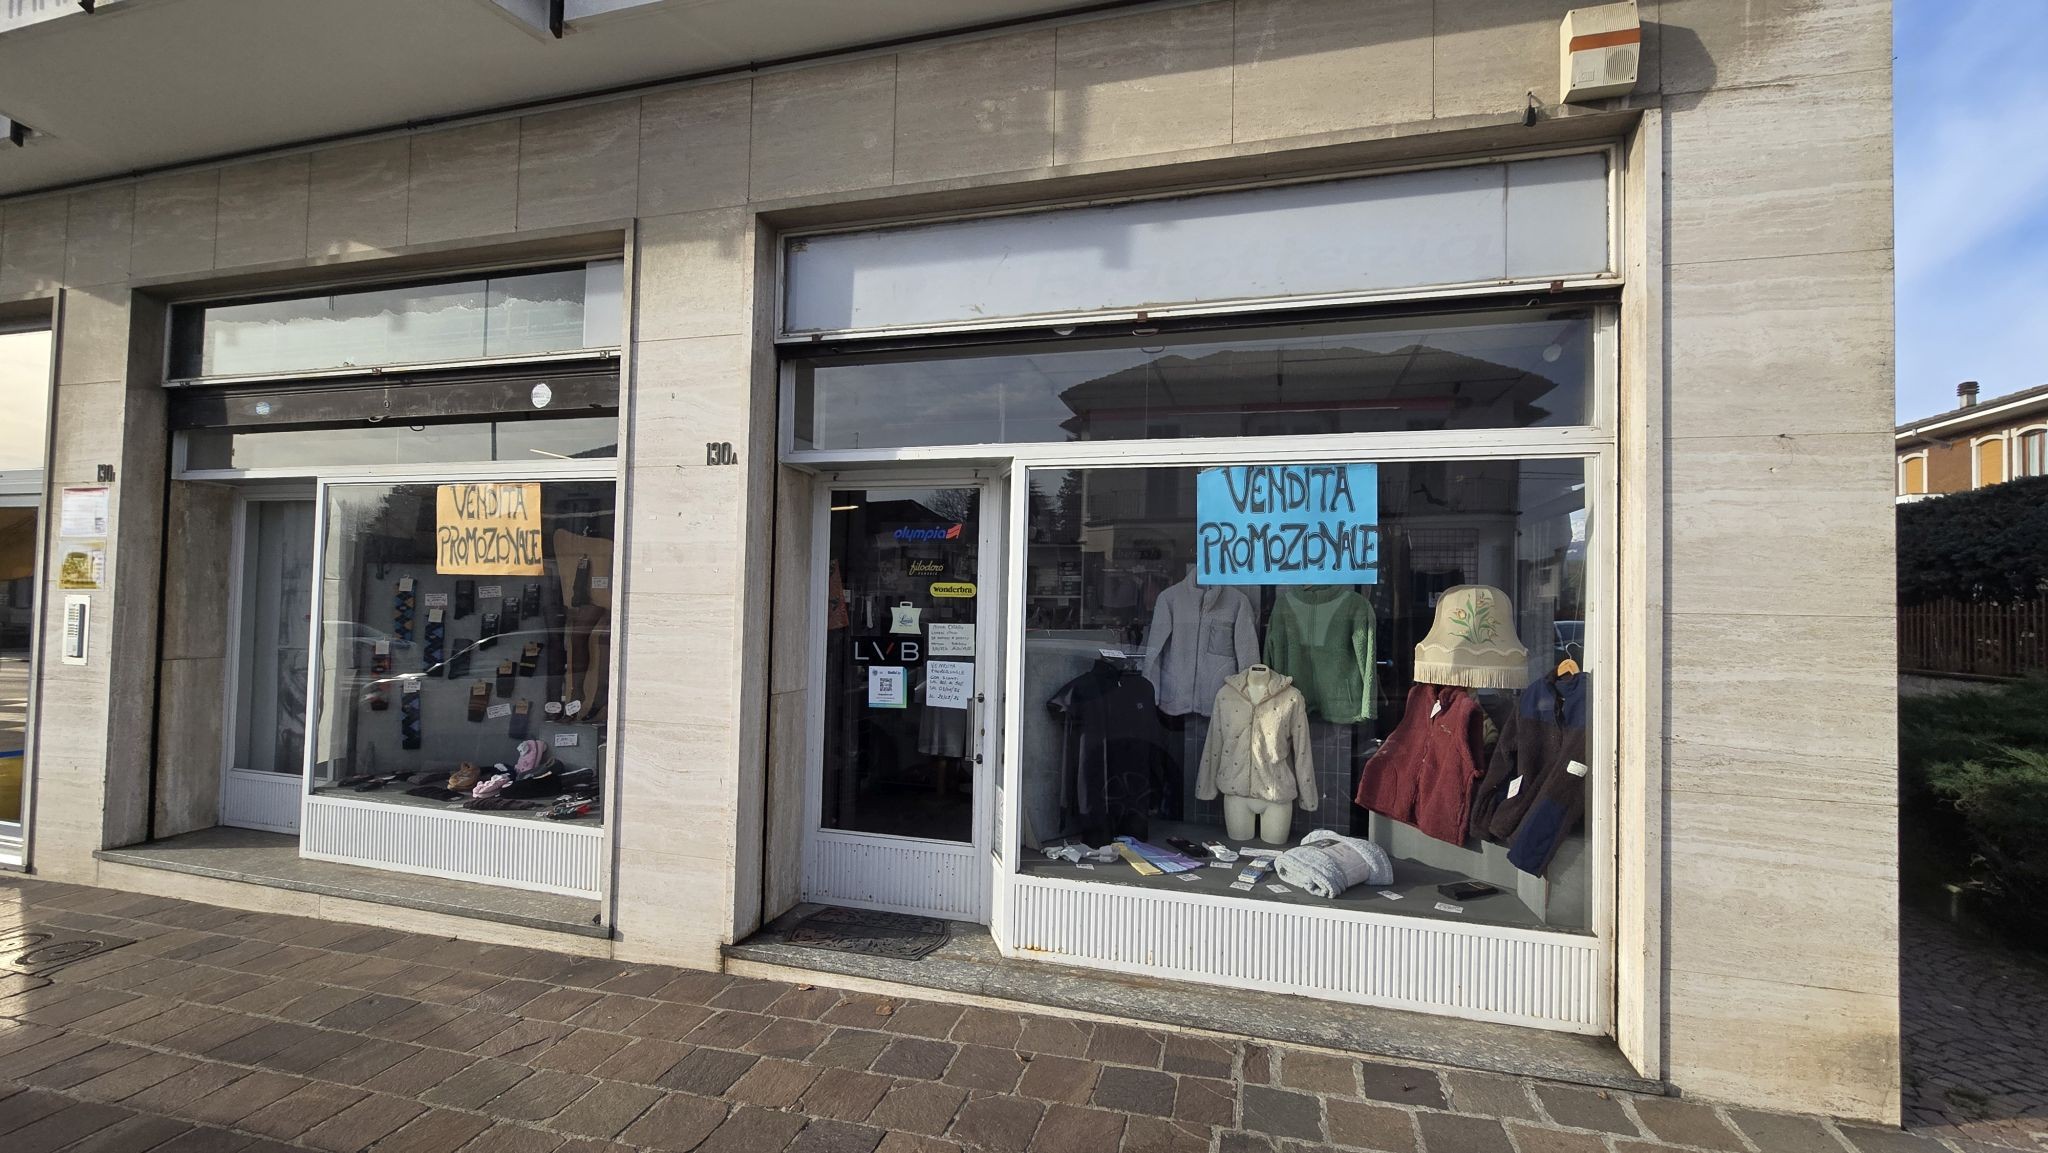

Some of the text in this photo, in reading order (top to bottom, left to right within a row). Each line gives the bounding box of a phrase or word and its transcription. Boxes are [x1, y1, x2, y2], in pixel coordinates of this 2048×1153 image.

[449, 485, 528, 520] VENDITA
[1221, 466, 1355, 514] VENDITA
[894, 526, 946, 542] olympia
